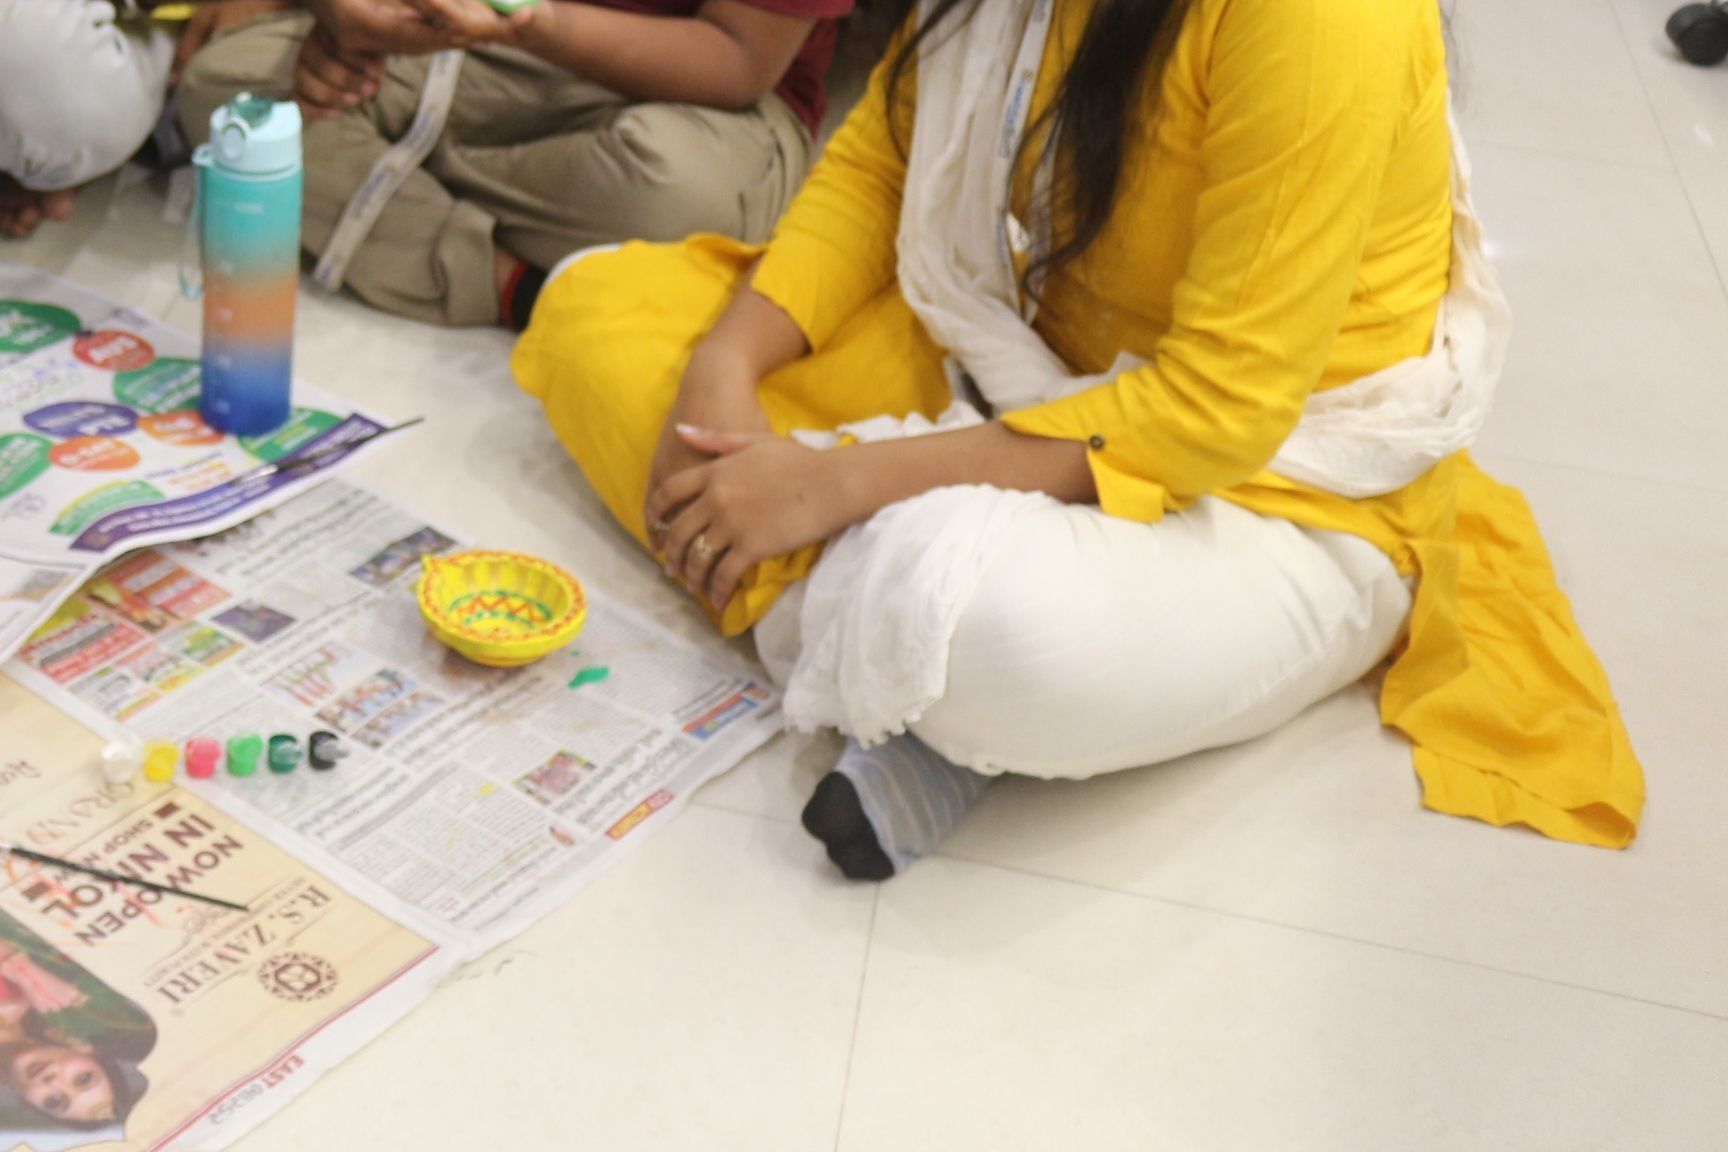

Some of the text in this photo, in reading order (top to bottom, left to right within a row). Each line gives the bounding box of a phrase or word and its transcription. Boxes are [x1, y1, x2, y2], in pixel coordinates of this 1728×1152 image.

[52, 818, 152, 884] SHOP NW
[163, 814, 213, 848] IN
[74, 835, 242, 946] NOW OPEN
[156, 885, 330, 1005] R.S. ZAVERI
[261, 1055, 304, 1088] EAST
